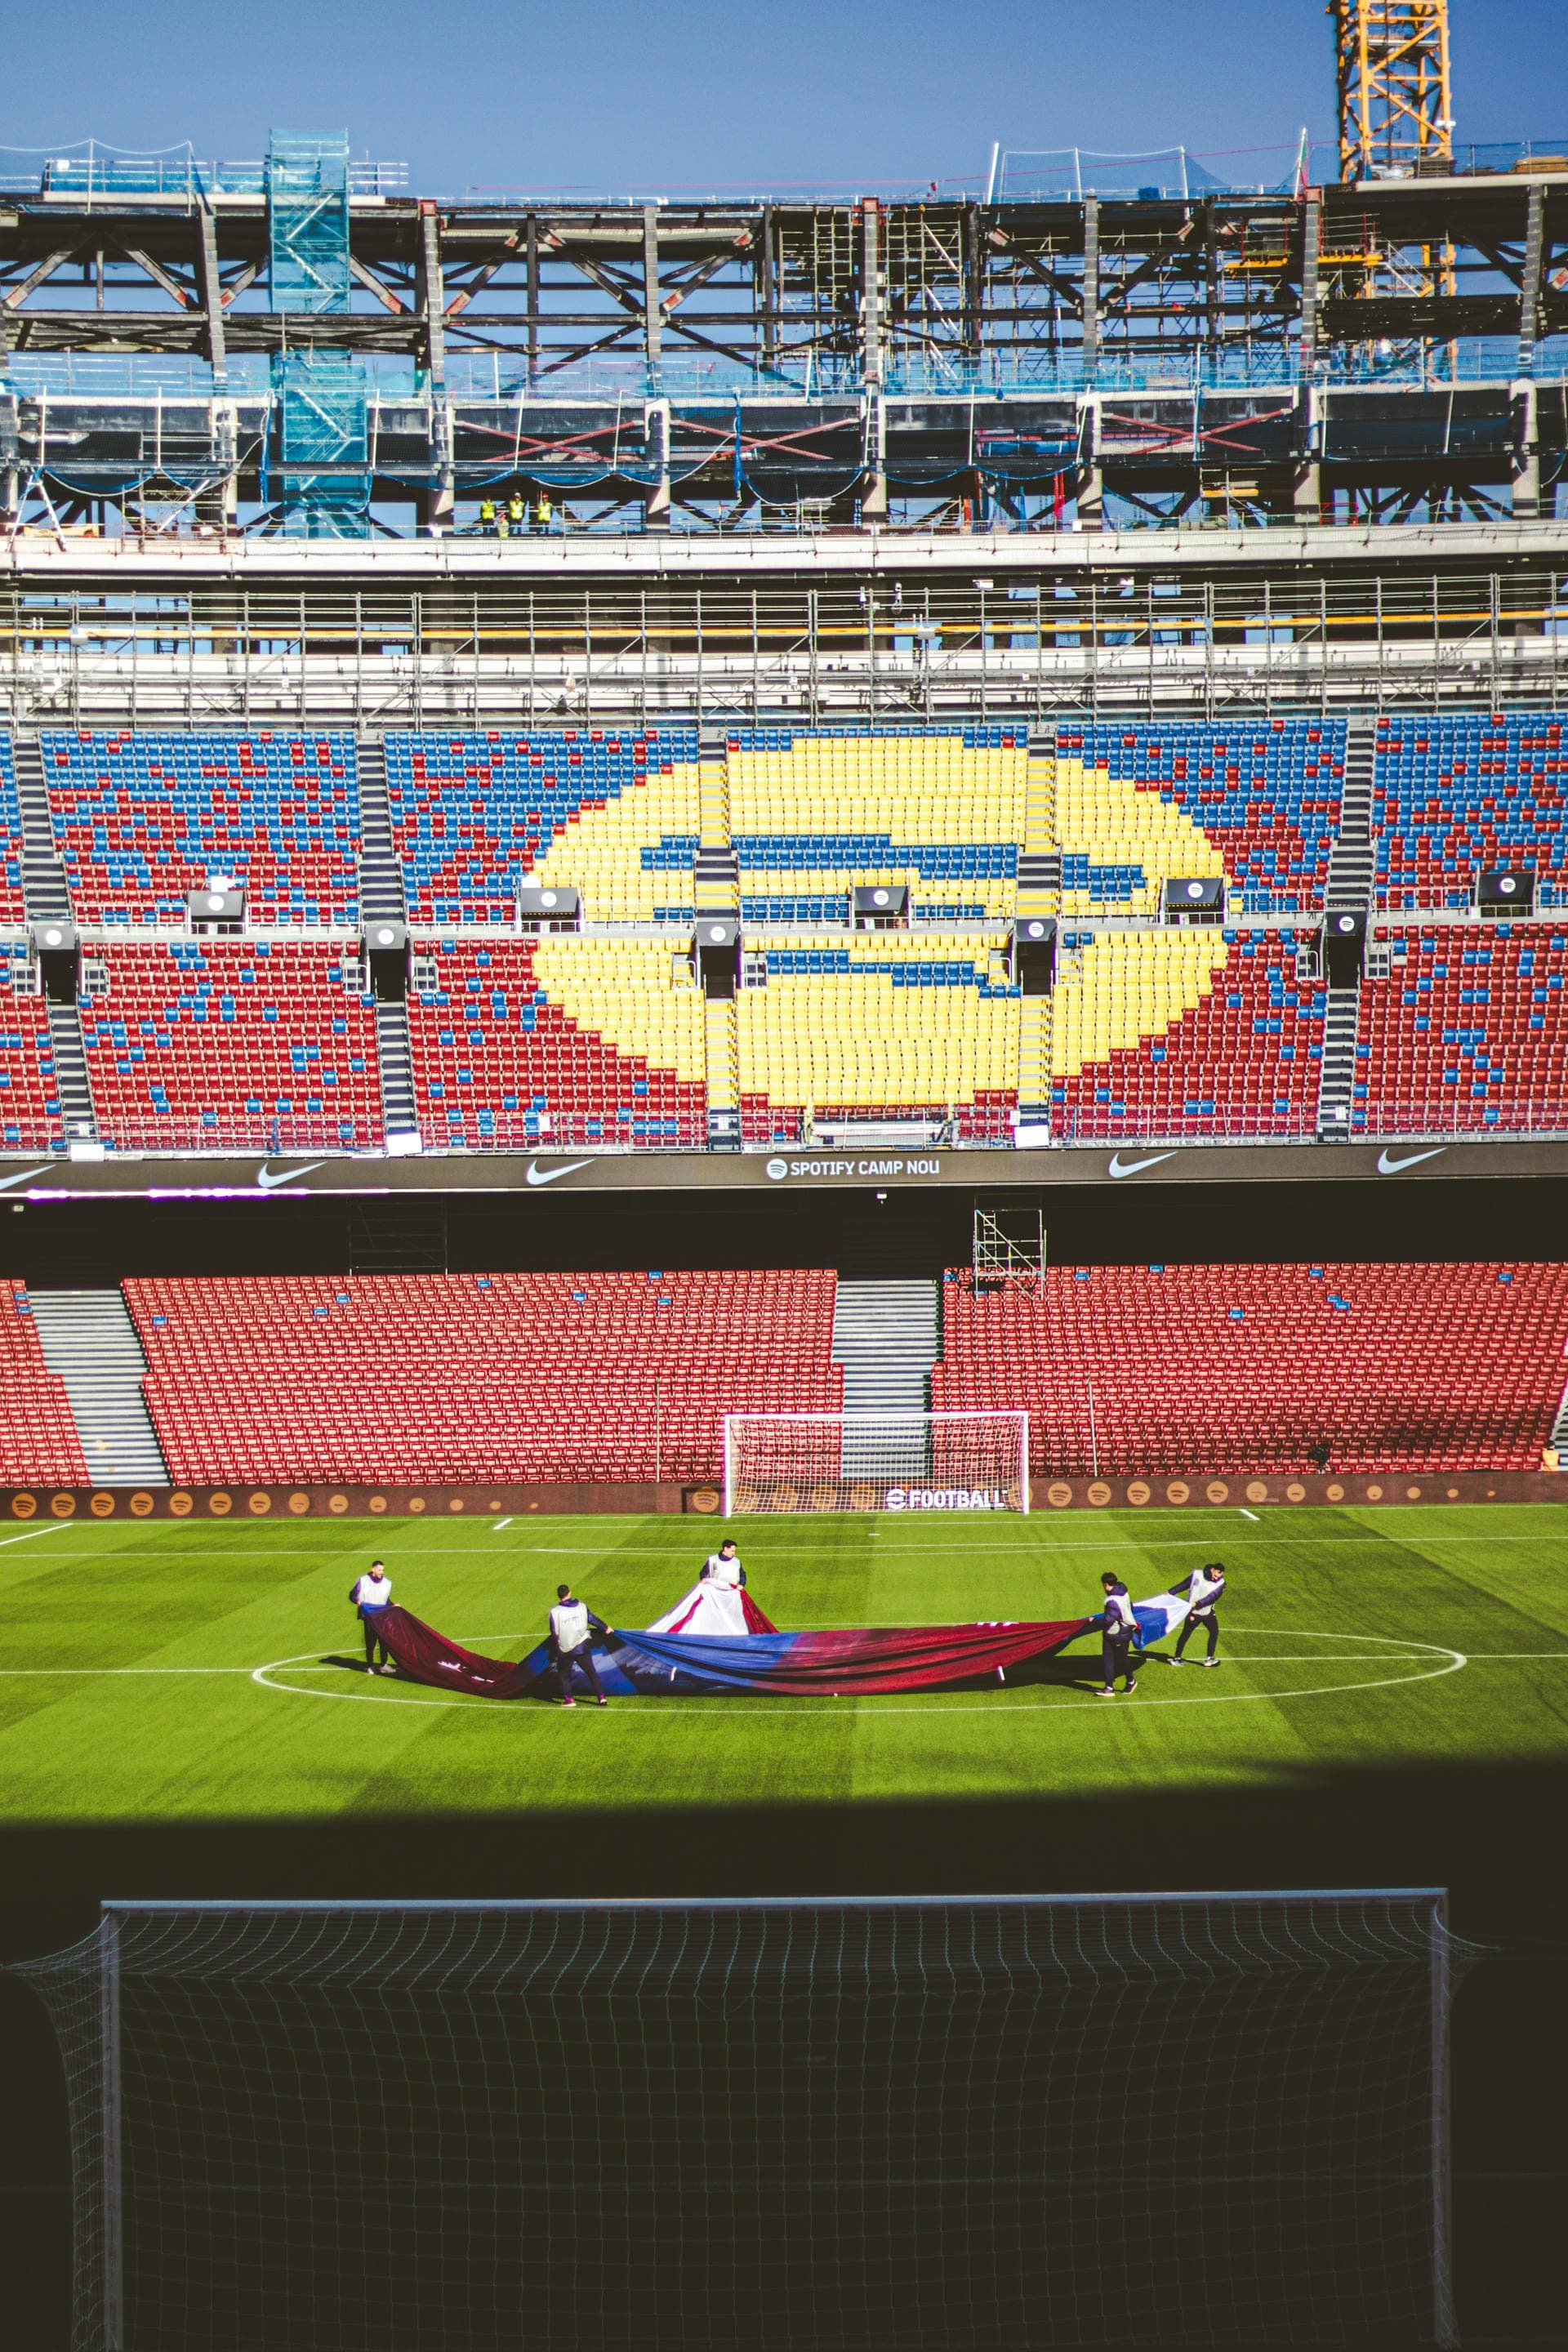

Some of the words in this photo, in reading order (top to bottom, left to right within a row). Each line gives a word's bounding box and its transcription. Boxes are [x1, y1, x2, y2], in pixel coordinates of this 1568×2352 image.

[790, 1160, 856, 1176] SPOTIFY
[858, 1160, 904, 1175] CAMP
[906, 1160, 940, 1174] NOU
